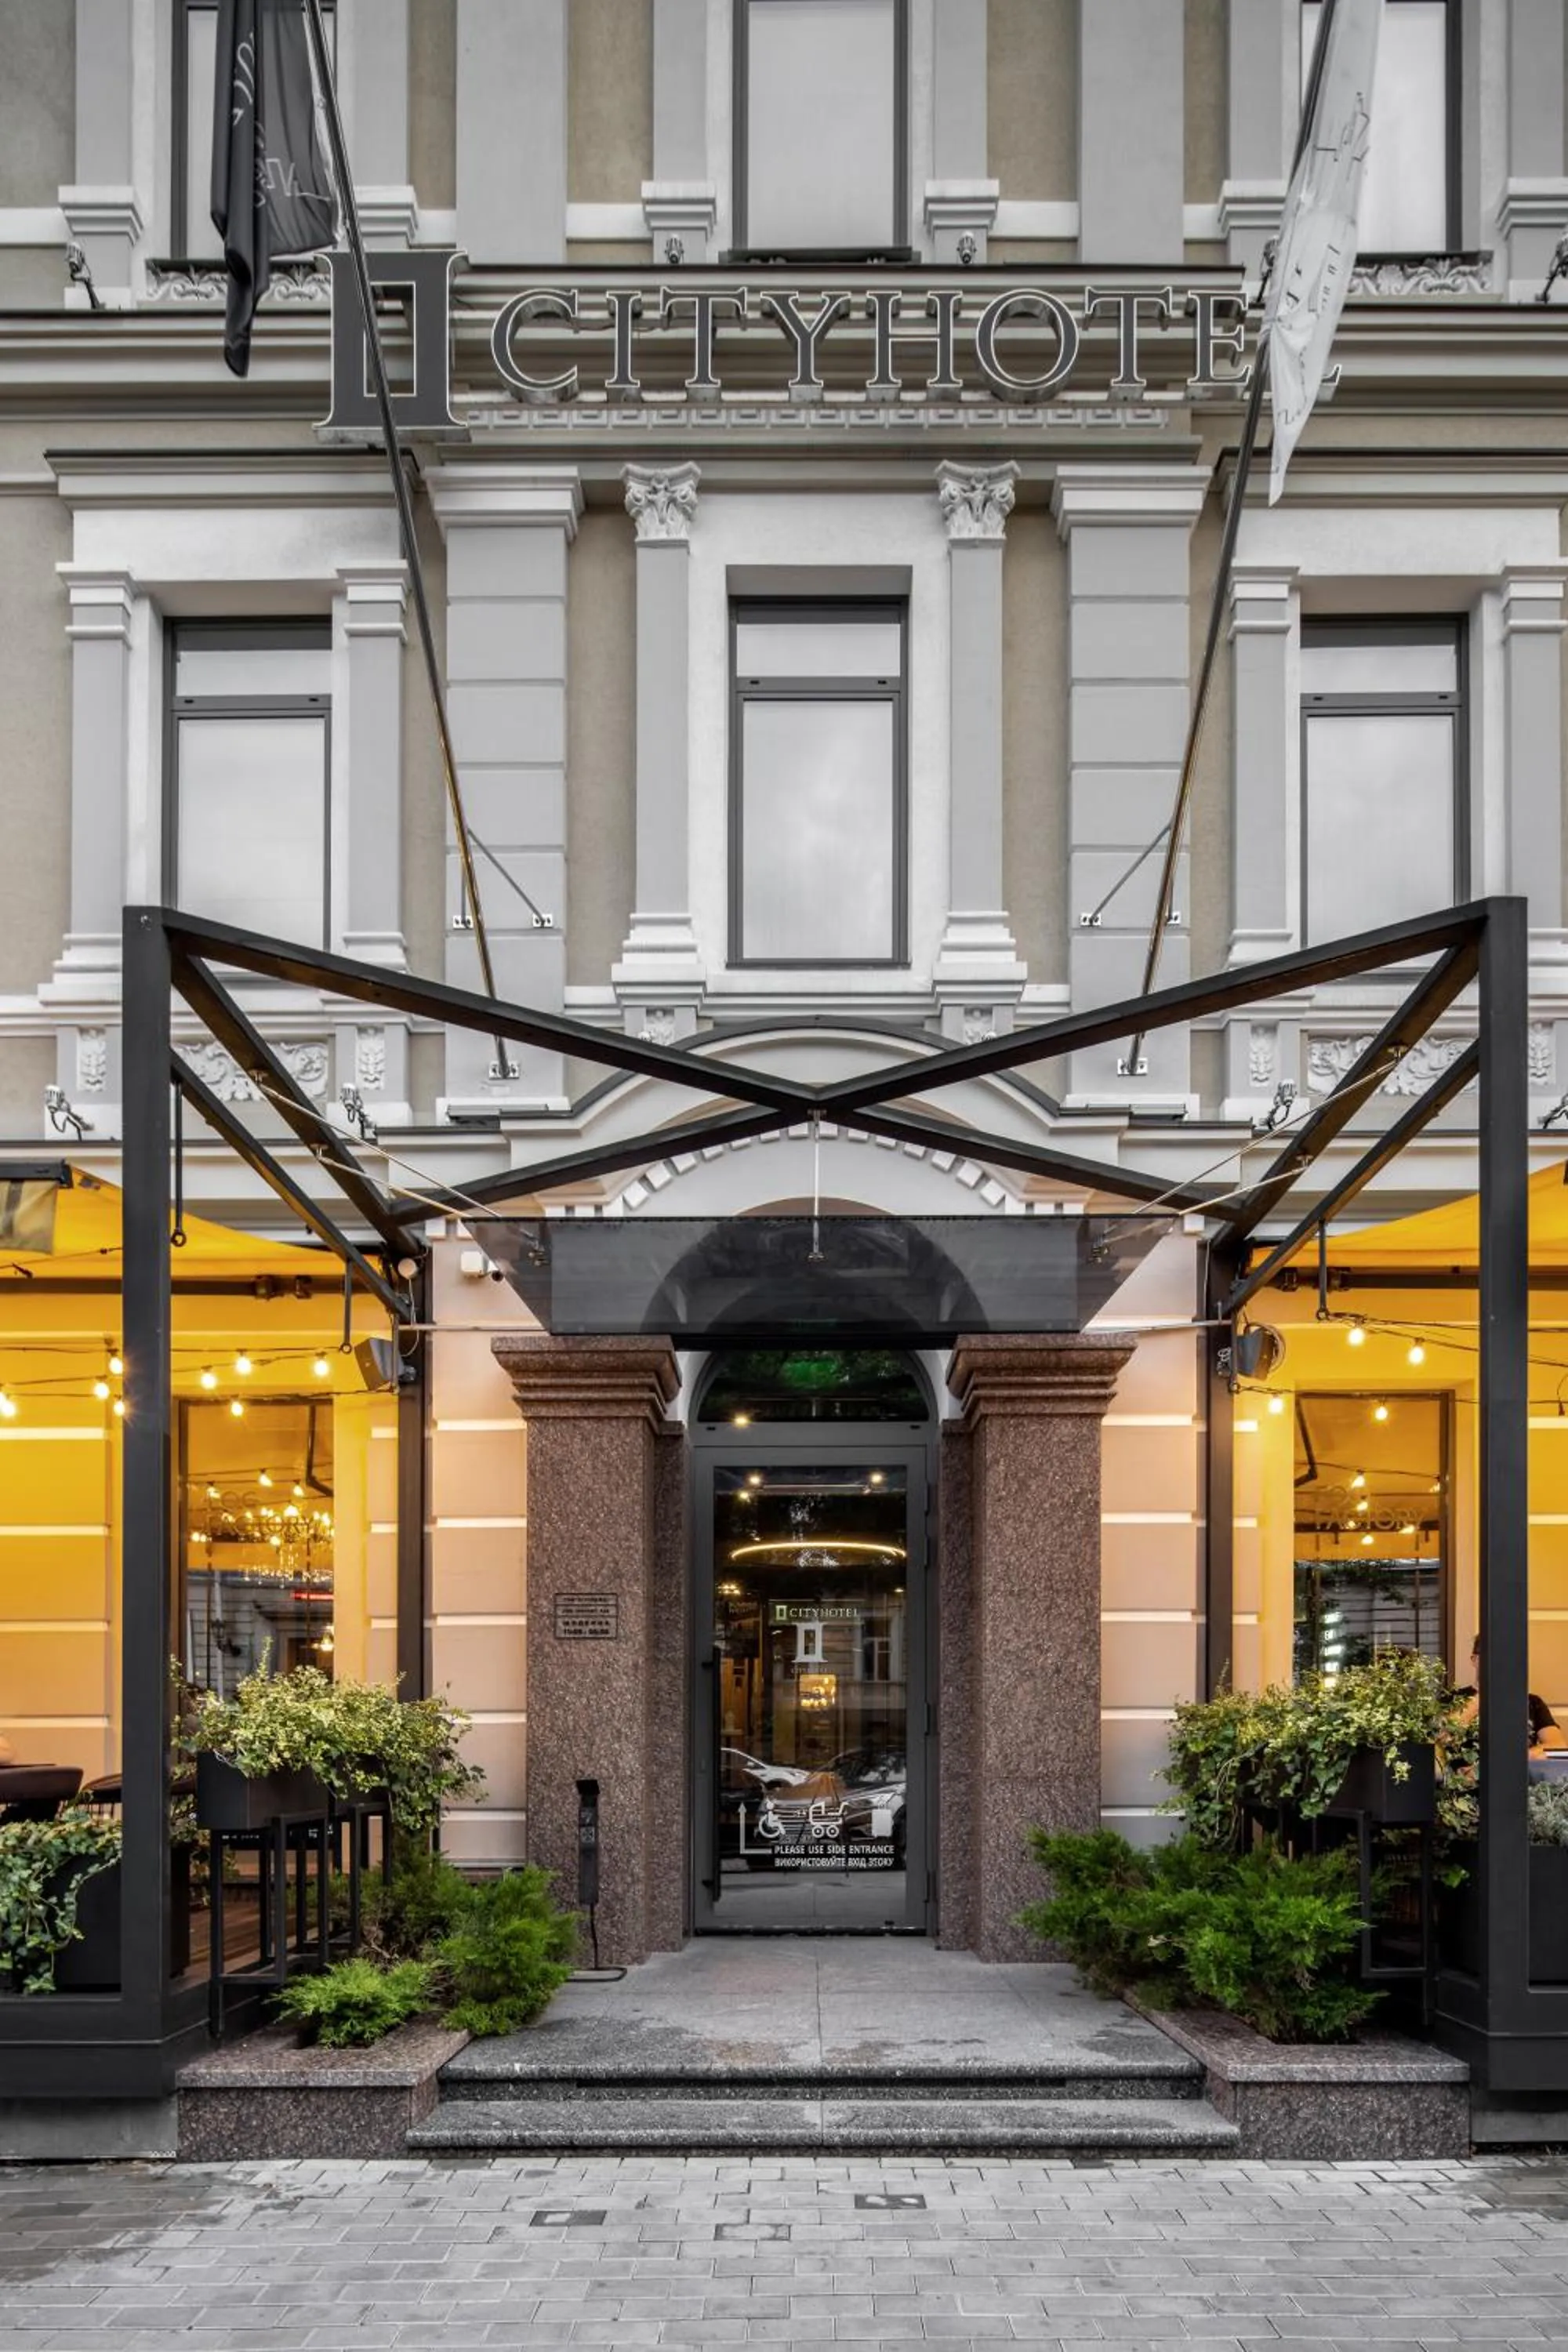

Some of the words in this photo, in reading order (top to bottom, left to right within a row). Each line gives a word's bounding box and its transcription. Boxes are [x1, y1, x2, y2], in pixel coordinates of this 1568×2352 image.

[491, 286, 1342, 391] CITYHOTE
[789, 1608, 859, 1617] CITYHOTEL
[774, 1845, 805, 1854] PLEASE
[808, 1845, 824, 1854] USE
[826, 1845, 846, 1854] SIDE
[849, 1845, 895, 1854] ENTRANCE
